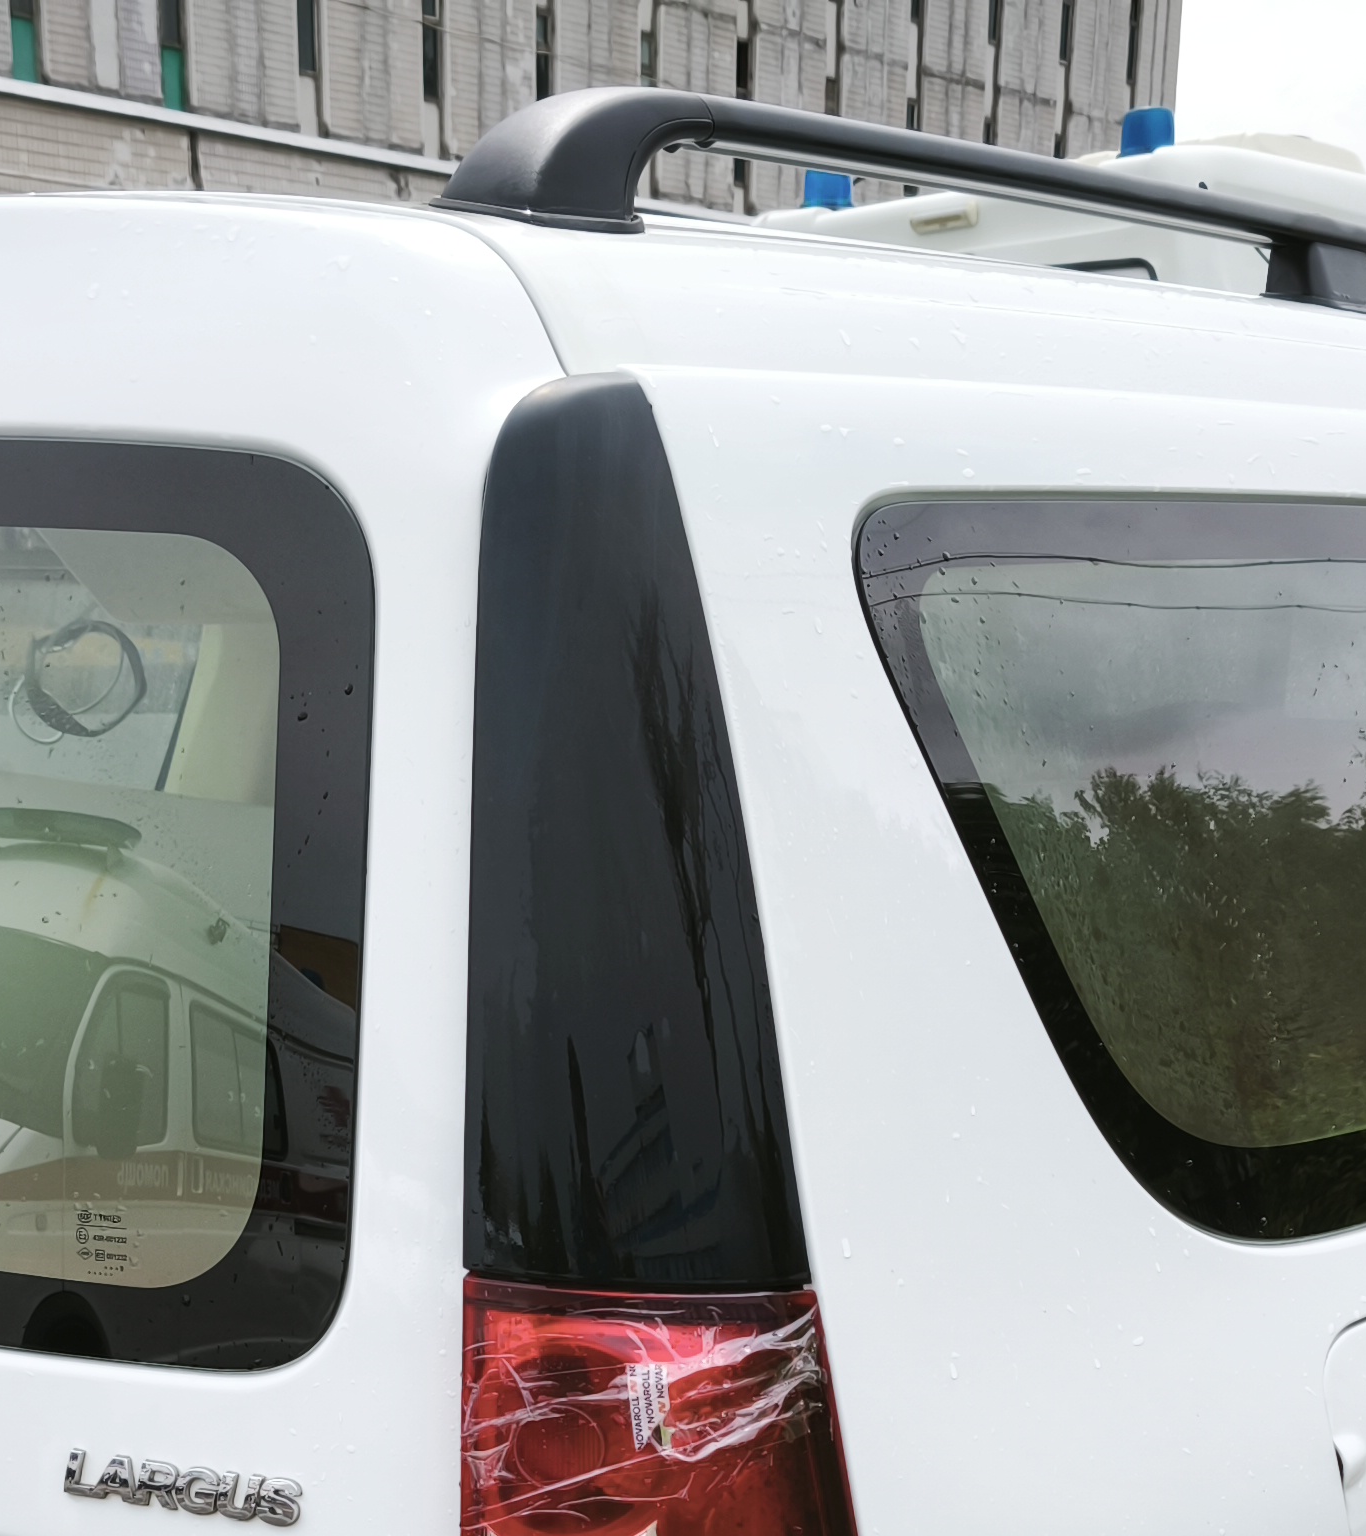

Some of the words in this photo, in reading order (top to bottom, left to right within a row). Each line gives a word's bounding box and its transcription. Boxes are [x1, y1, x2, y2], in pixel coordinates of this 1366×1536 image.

[632, 1396, 644, 1451] NOVAROLL
[642, 1370, 655, 1425] NOVAROLL
[63, 1447, 303, 1527] LARGUS
